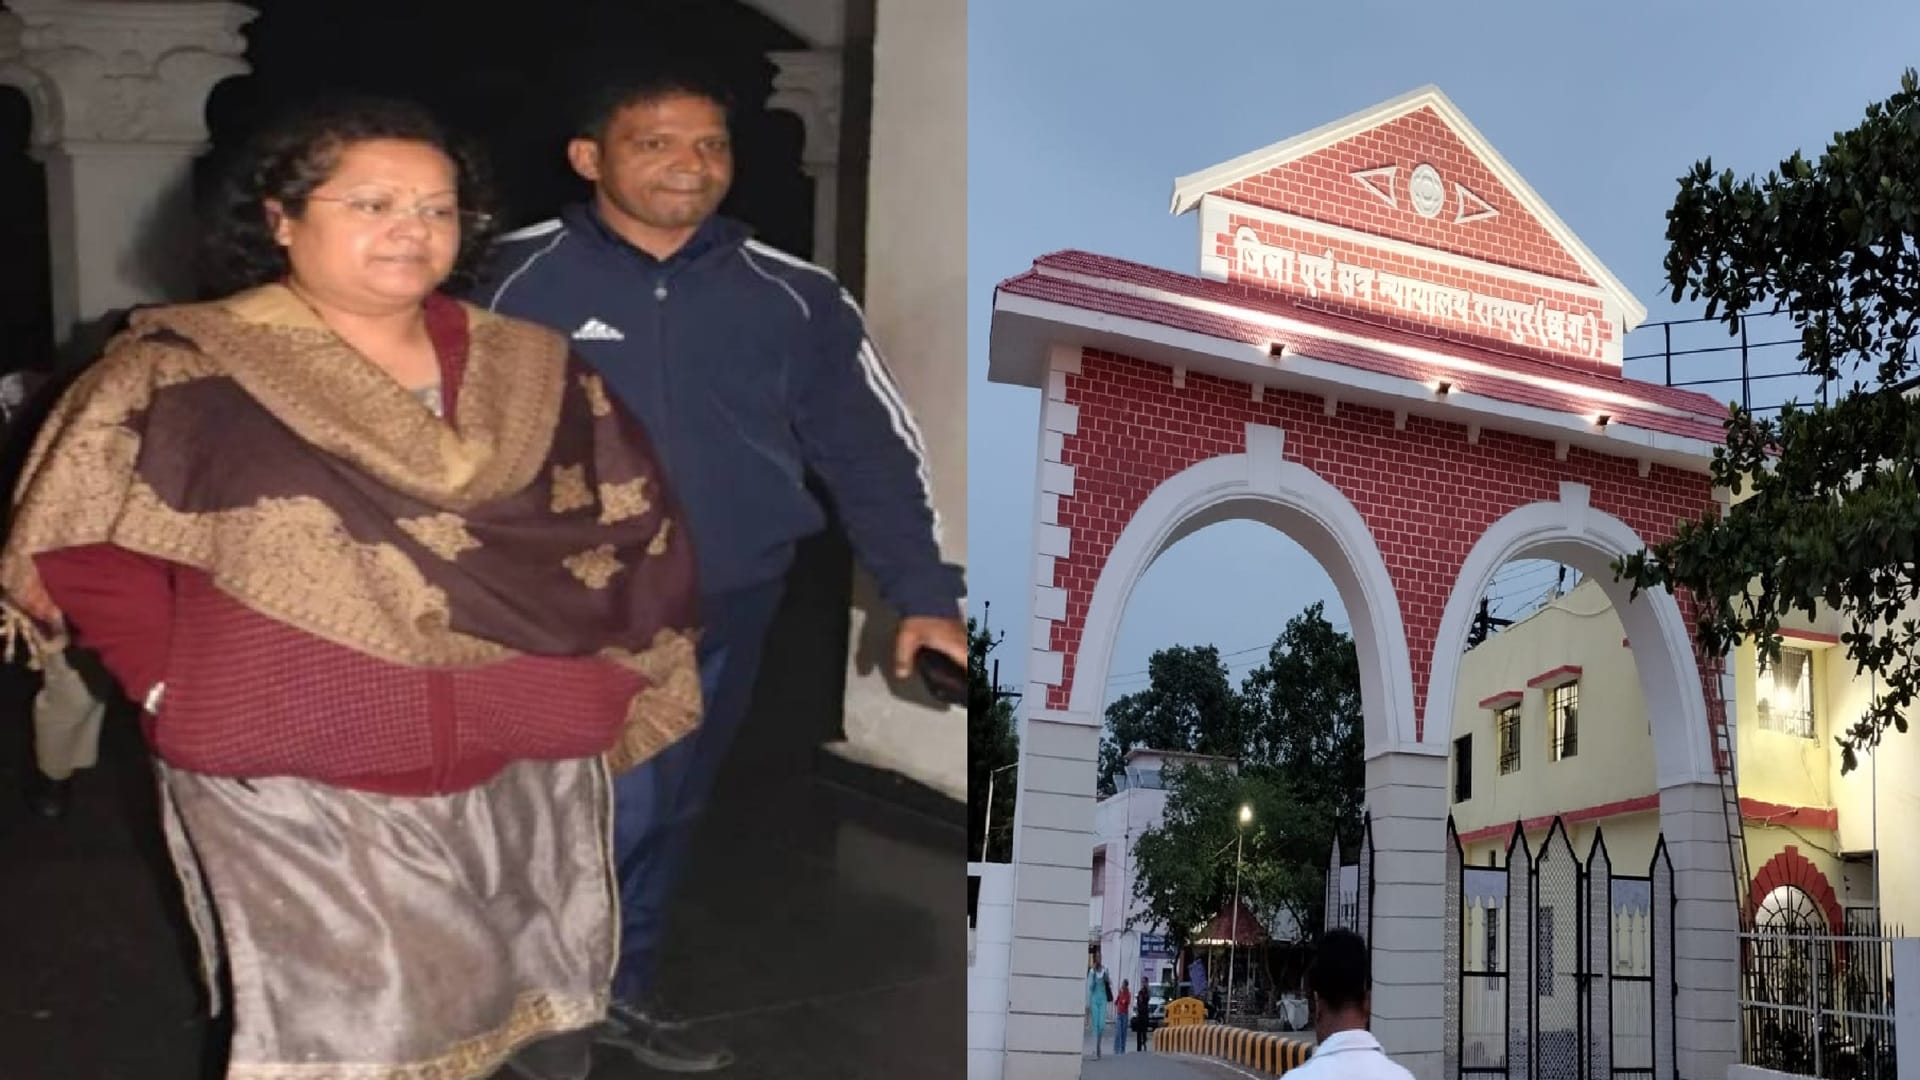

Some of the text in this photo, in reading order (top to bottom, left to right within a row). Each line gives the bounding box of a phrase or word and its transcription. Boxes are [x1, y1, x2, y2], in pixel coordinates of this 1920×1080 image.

[1234, 226, 1296, 284] जिला
[1298, 248, 1335, 298] एवं
[1377, 271, 1470, 324] न्यायालय
